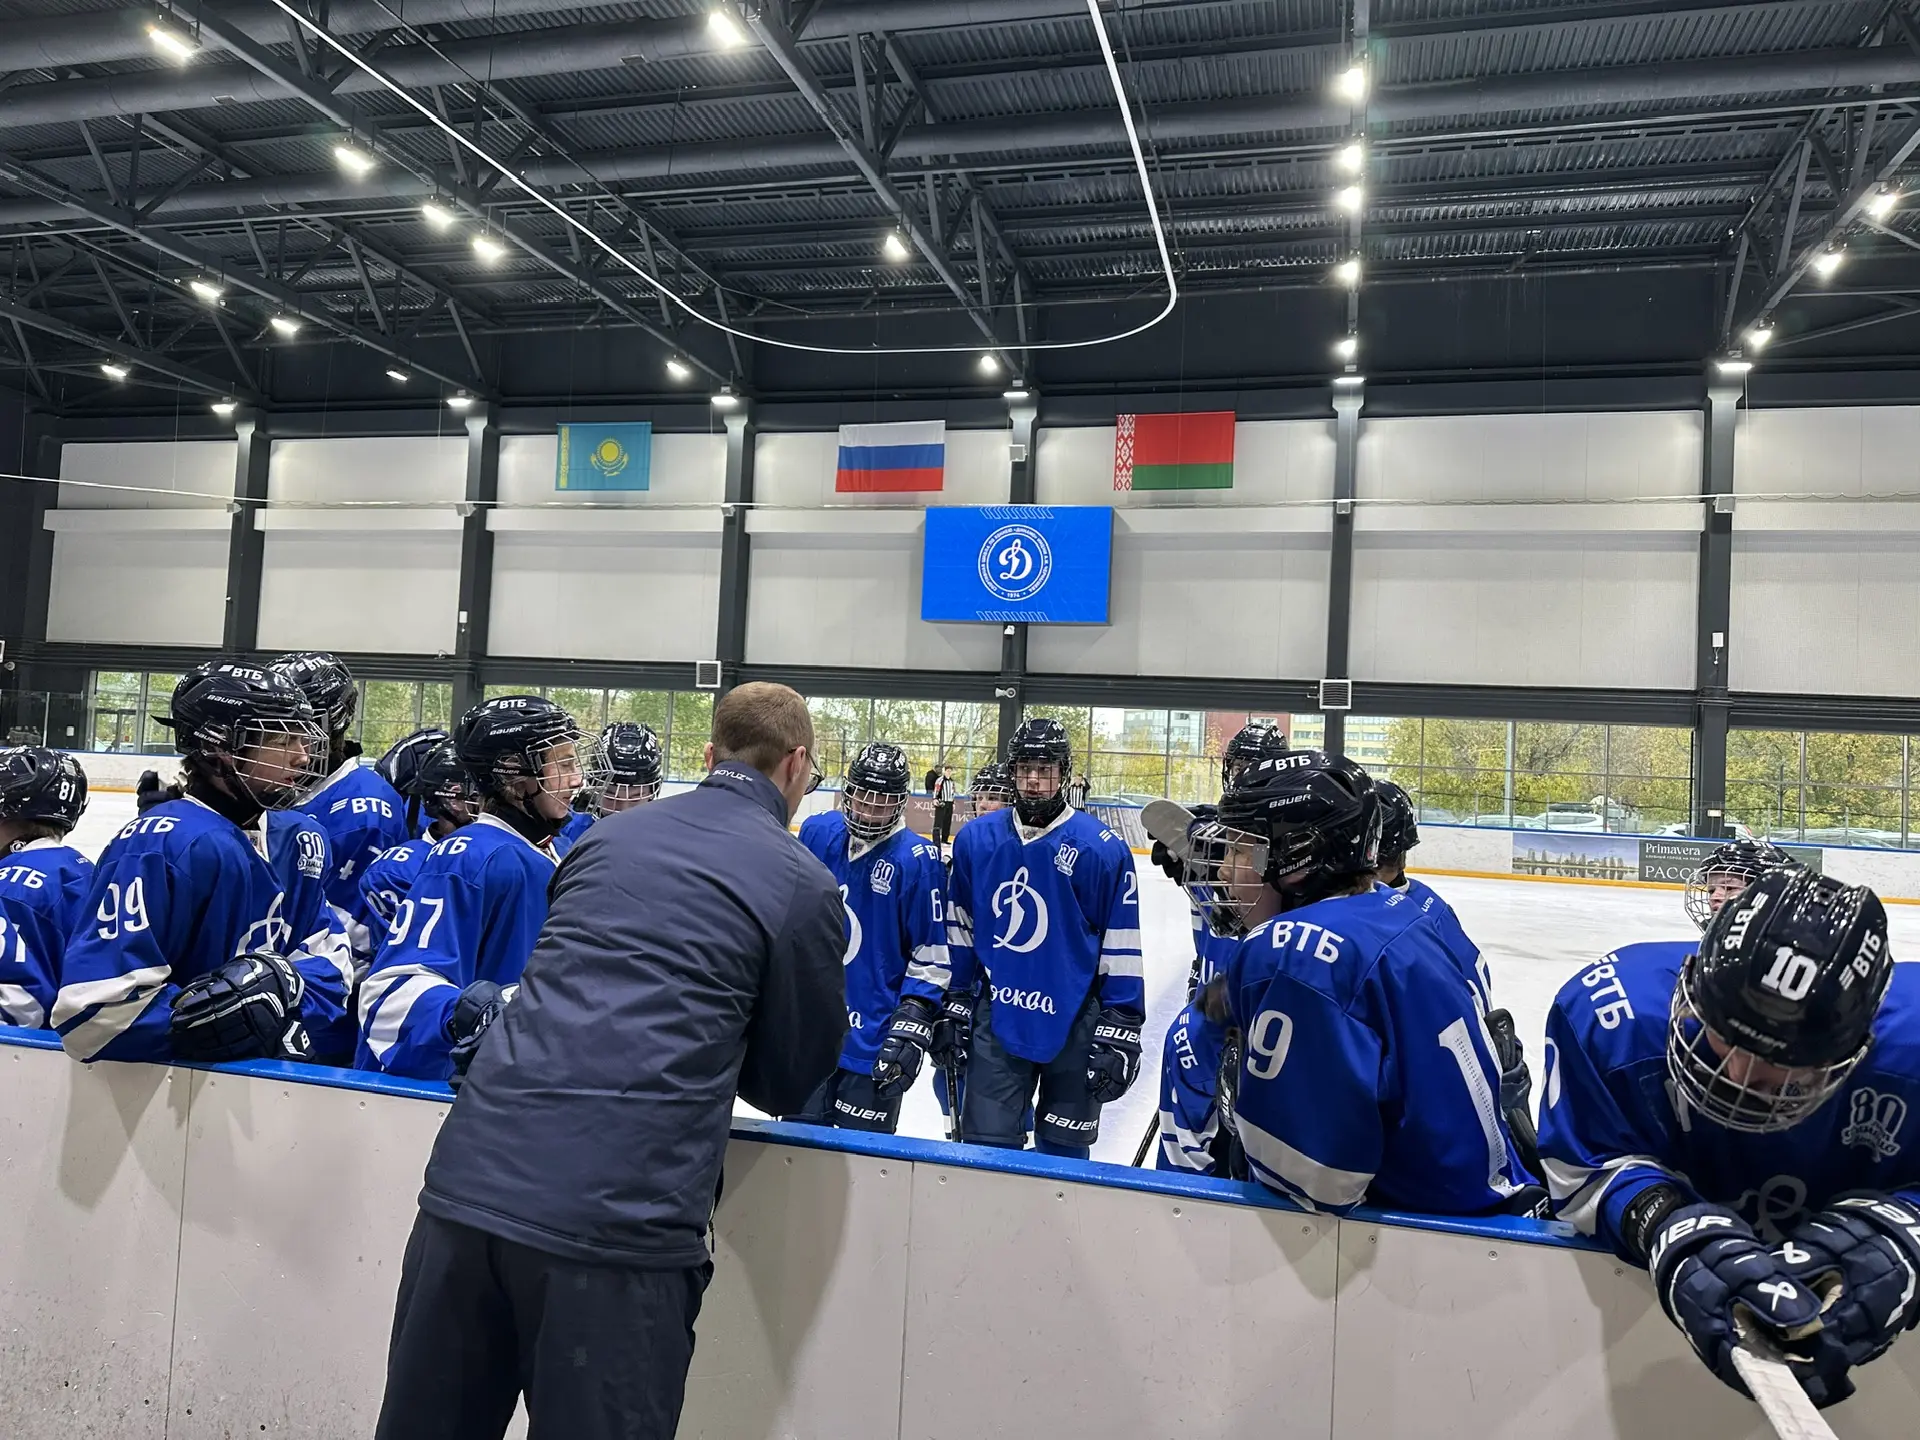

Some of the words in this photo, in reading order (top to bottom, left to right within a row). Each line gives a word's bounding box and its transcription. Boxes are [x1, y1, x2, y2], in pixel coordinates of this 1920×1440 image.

[231, 667, 263, 681] ВТБ
[499, 699, 527, 709] ВТБ
[1275, 755, 1311, 771] ВТБ
[58, 781, 76, 801] 81
[351, 797, 393, 819] ВТБ
[120, 816, 181, 840] ВТБ
[296, 831, 325, 860] 80
[1645, 842, 1701, 856] Primavera
[872, 859, 895, 881] 80
[97, 876, 150, 940] 99
[387, 897, 444, 949] 97
[1724, 909, 1755, 951] ВТБ
[1271, 920, 1345, 964] ВТБ
[1852, 929, 1882, 979] ВТБ
[1761, 946, 1818, 1001] 10
[1581, 963, 1636, 1030] ВТБ
[1173, 1027, 1199, 1070] ВТБ
[835, 1098, 887, 1122] BAUER
[1044, 1112, 1099, 1131] BAUER
[1851, 1086, 1908, 1142] 80
